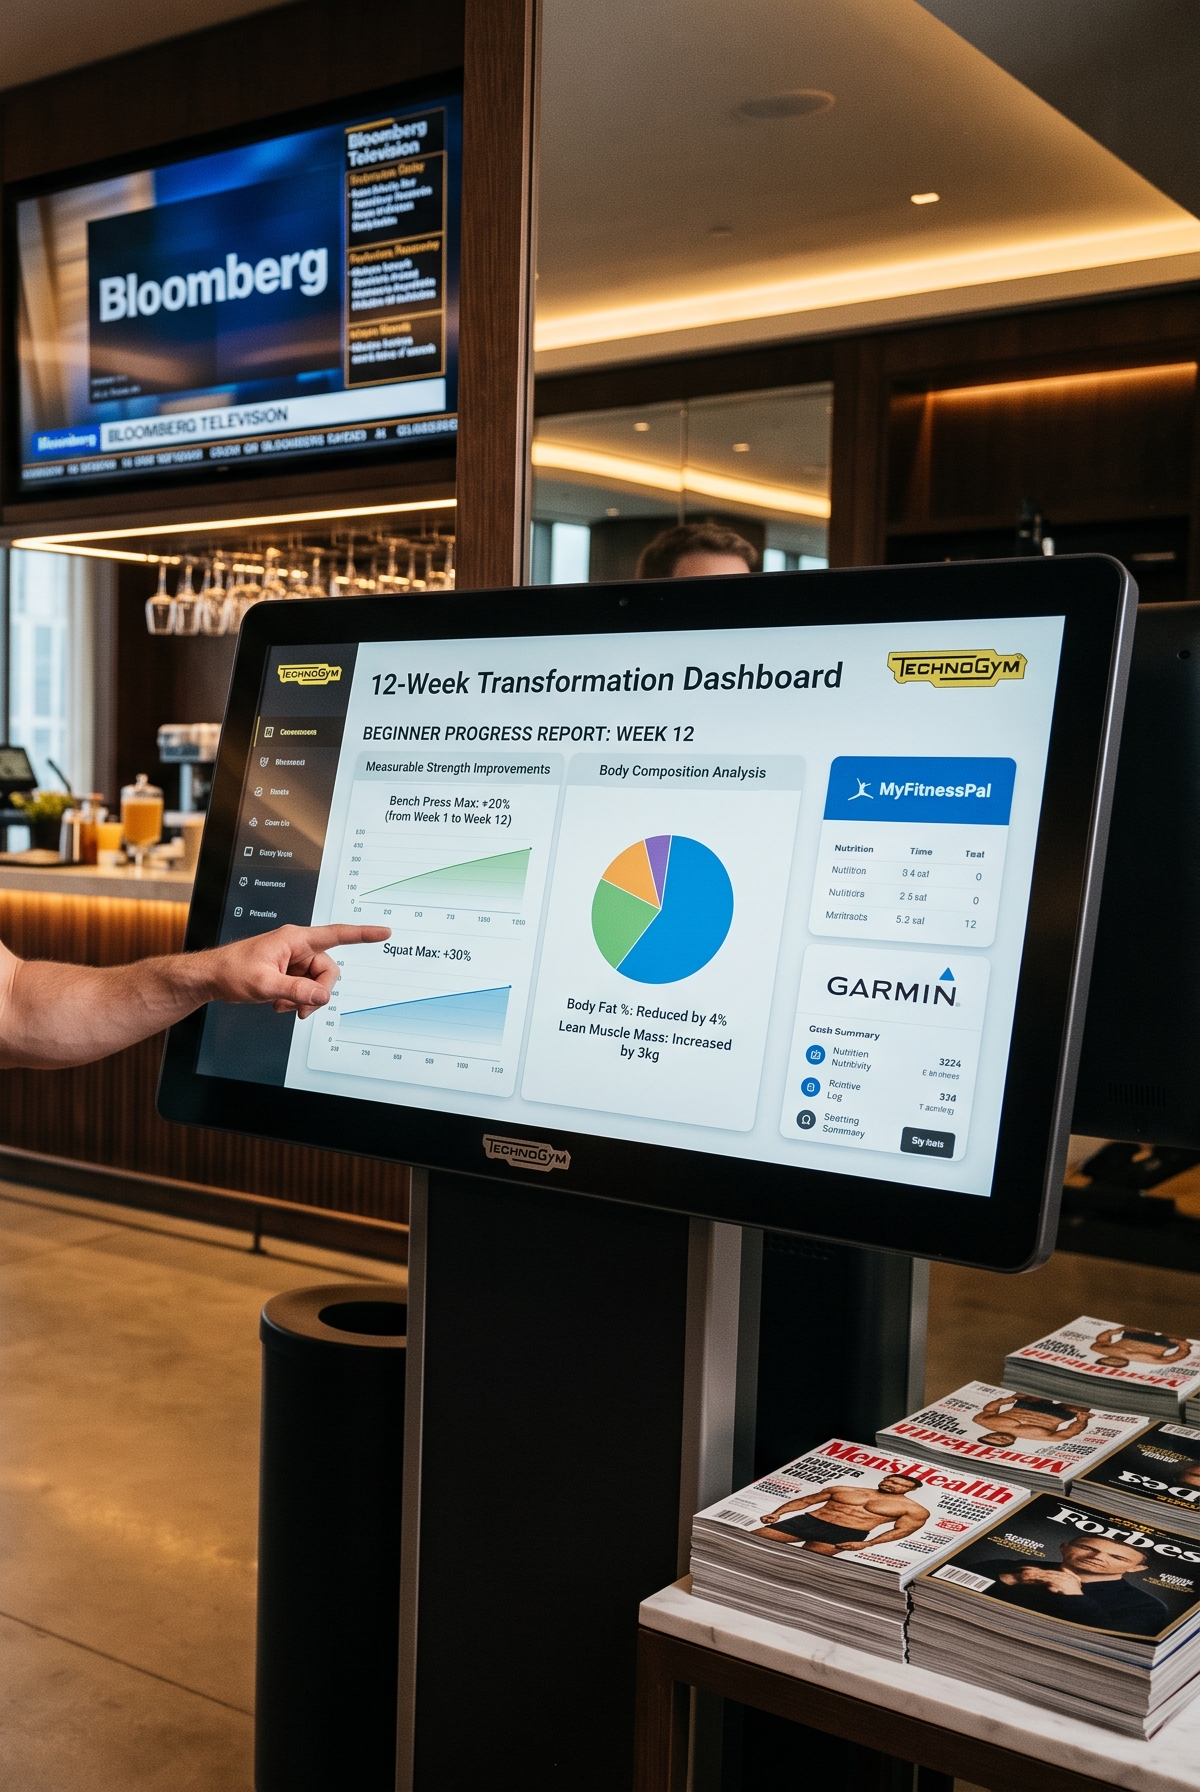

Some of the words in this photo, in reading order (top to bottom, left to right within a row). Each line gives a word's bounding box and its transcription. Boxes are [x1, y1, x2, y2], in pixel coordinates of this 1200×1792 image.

[99, 248, 328, 322] Bloomberg
[108, 420, 196, 444] BLOOMBERG
[201, 406, 288, 430] TELEVISION
[371, 671, 469, 696] 12-Week
[477, 667, 673, 695] Transformation
[684, 661, 843, 691] Dashboard
[363, 726, 441, 741] BEGINNER
[445, 726, 533, 741] PROGRESS
[537, 726, 611, 742] REPORT:
[616, 726, 667, 742] WEEK
[673, 726, 695, 742] 12
[366, 761, 424, 773] Measurable
[427, 762, 471, 775] Strength
[473, 763, 550, 777] Improvements
[599, 764, 629, 779] Body
[631, 765, 709, 781] Composition
[712, 766, 766, 782] Analysis
[879, 782, 991, 800] MyFitnessPal
[390, 796, 420, 807] Bench
[423, 797, 451, 808] Press
[454, 798, 479, 809] Max:
[482, 798, 510, 810] +20%
[385, 810, 411, 823] (from
[414, 812, 440, 823] Week
[444, 813, 448, 823] 1
[451, 814, 461, 824] to
[464, 814, 492, 825] Week
[495, 815, 512, 828] 12)
[834, 844, 874, 853] Nutrition
[383, 943, 412, 957] Squat
[415, 946, 440, 959] Max:
[443, 949, 472, 962] +30%
[827, 975, 957, 1007] GARMIN
[566, 998, 596, 1014] Body
[598, 1001, 618, 1015] Fat
[620, 1003, 633, 1017] %:
[636, 1005, 688, 1022] Reduced
[691, 1010, 707, 1026] by
[709, 1013, 728, 1027] 4%
[558, 1020, 586, 1034] Lean
[589, 1023, 631, 1040] Muscle
[633, 1028, 669, 1044] Mass:
[671, 1033, 732, 1051] Increased
[834, 1028, 880, 1041] Summary
[620, 1044, 635, 1061] by
[637, 1046, 660, 1063] 3kg
[826, 1091, 843, 1102] Log
[1047, 1506, 1200, 1563] Forbes
